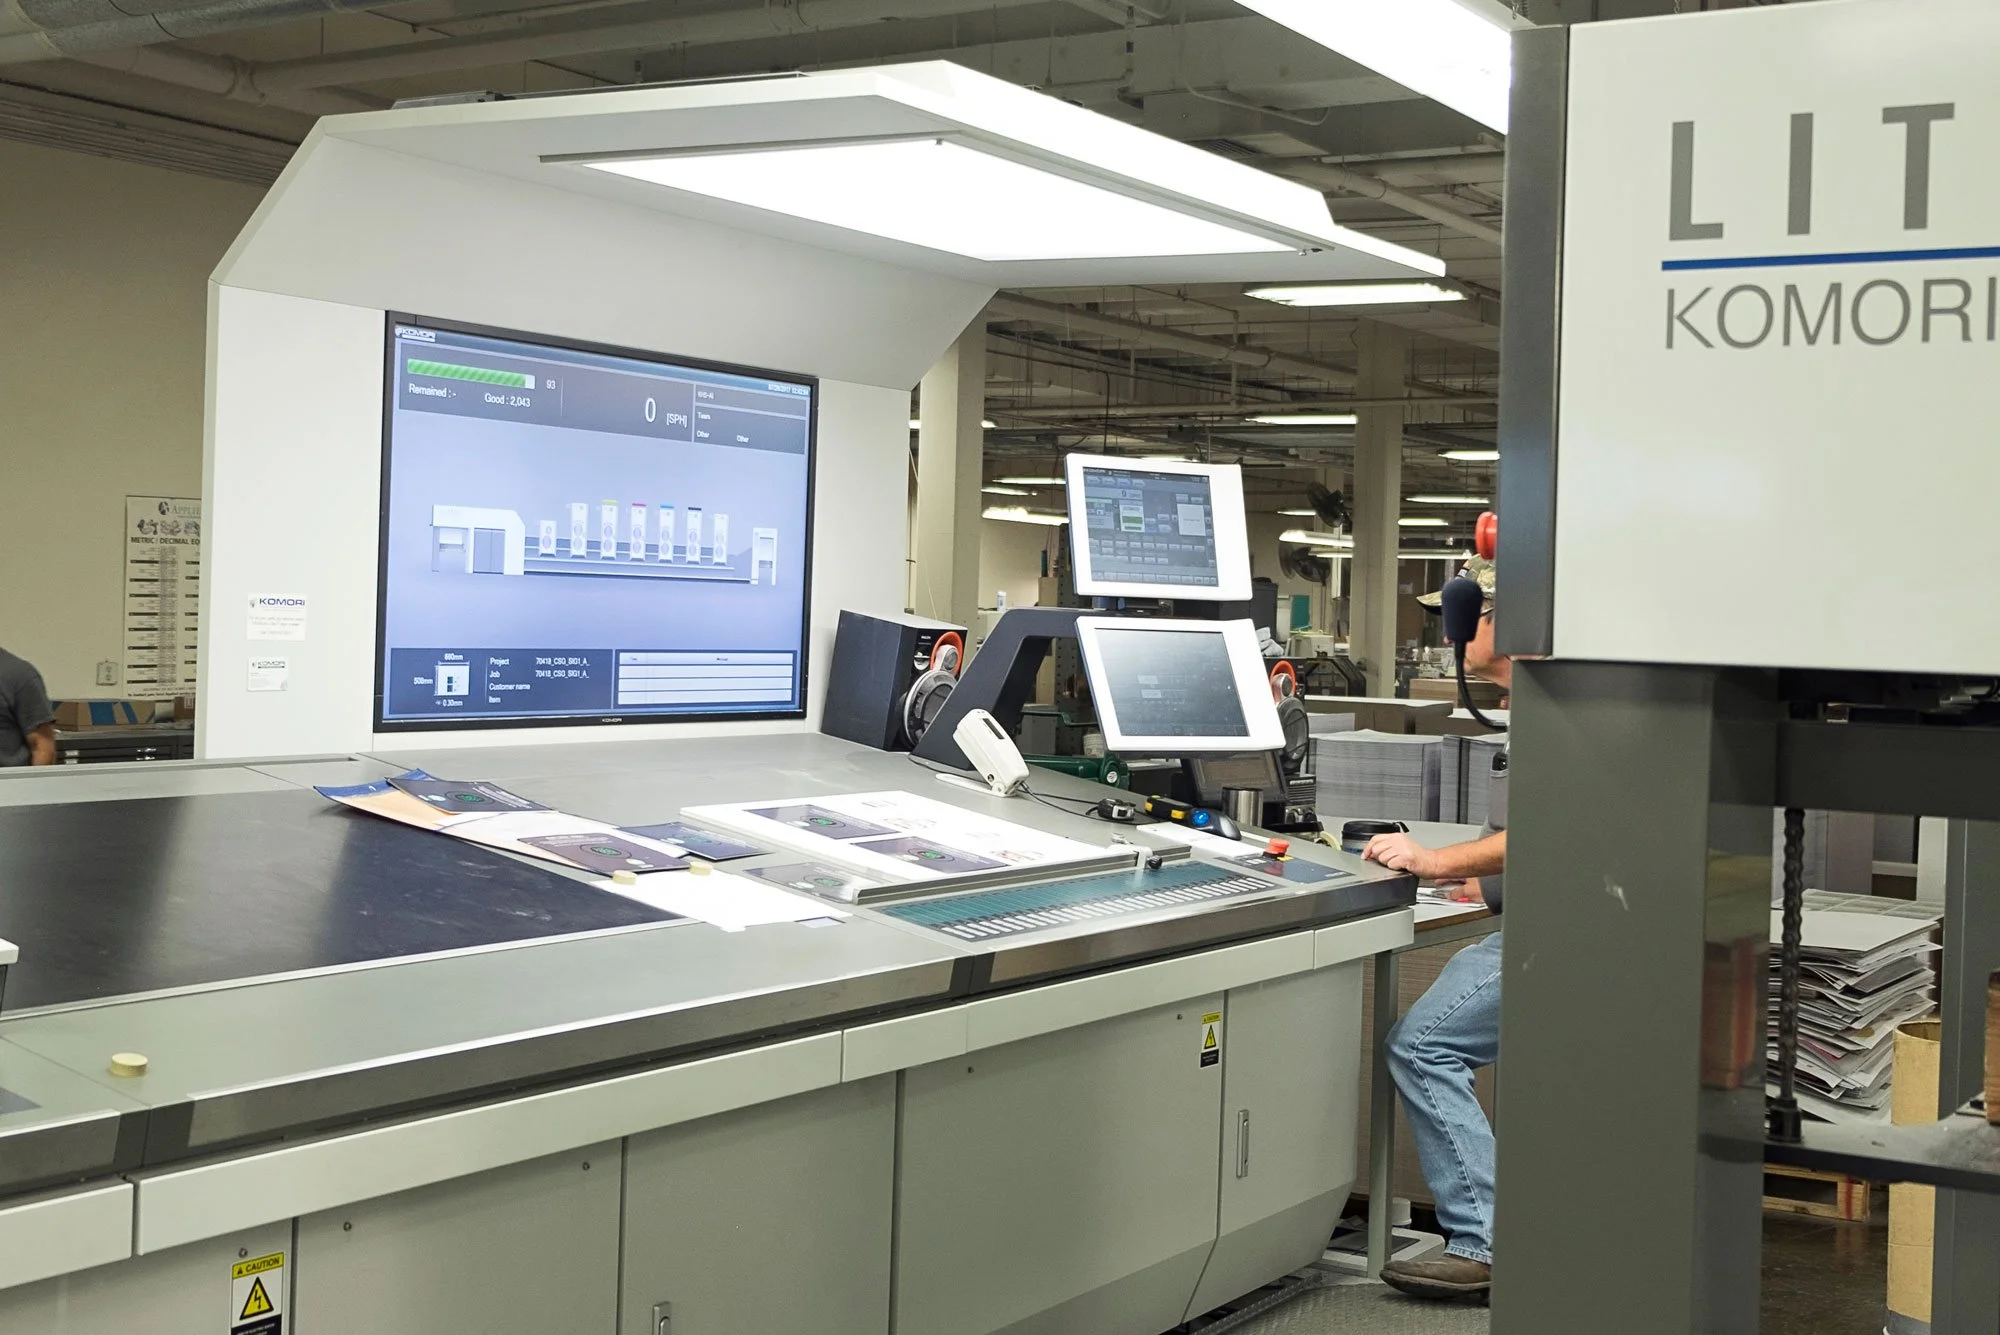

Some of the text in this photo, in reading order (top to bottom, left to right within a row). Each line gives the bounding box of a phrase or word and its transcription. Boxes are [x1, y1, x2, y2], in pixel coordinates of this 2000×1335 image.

[1665, 276, 1997, 350] KOMORI
[408, 382, 447, 398] Remained
[546, 379, 556, 390] 93
[484, 393, 504, 405] Good
[510, 396, 531, 408] 2,043
[645, 397, 656, 422] 0
[130, 536, 154, 544] METRIC
[159, 537, 189, 545] DECIMAL
[259, 598, 306, 606] KOMORI
[489, 657, 510, 667] Project
[489, 670, 501, 678] Job
[488, 683, 515, 691] Customer
[245, 1256, 280, 1273] CAUTION
